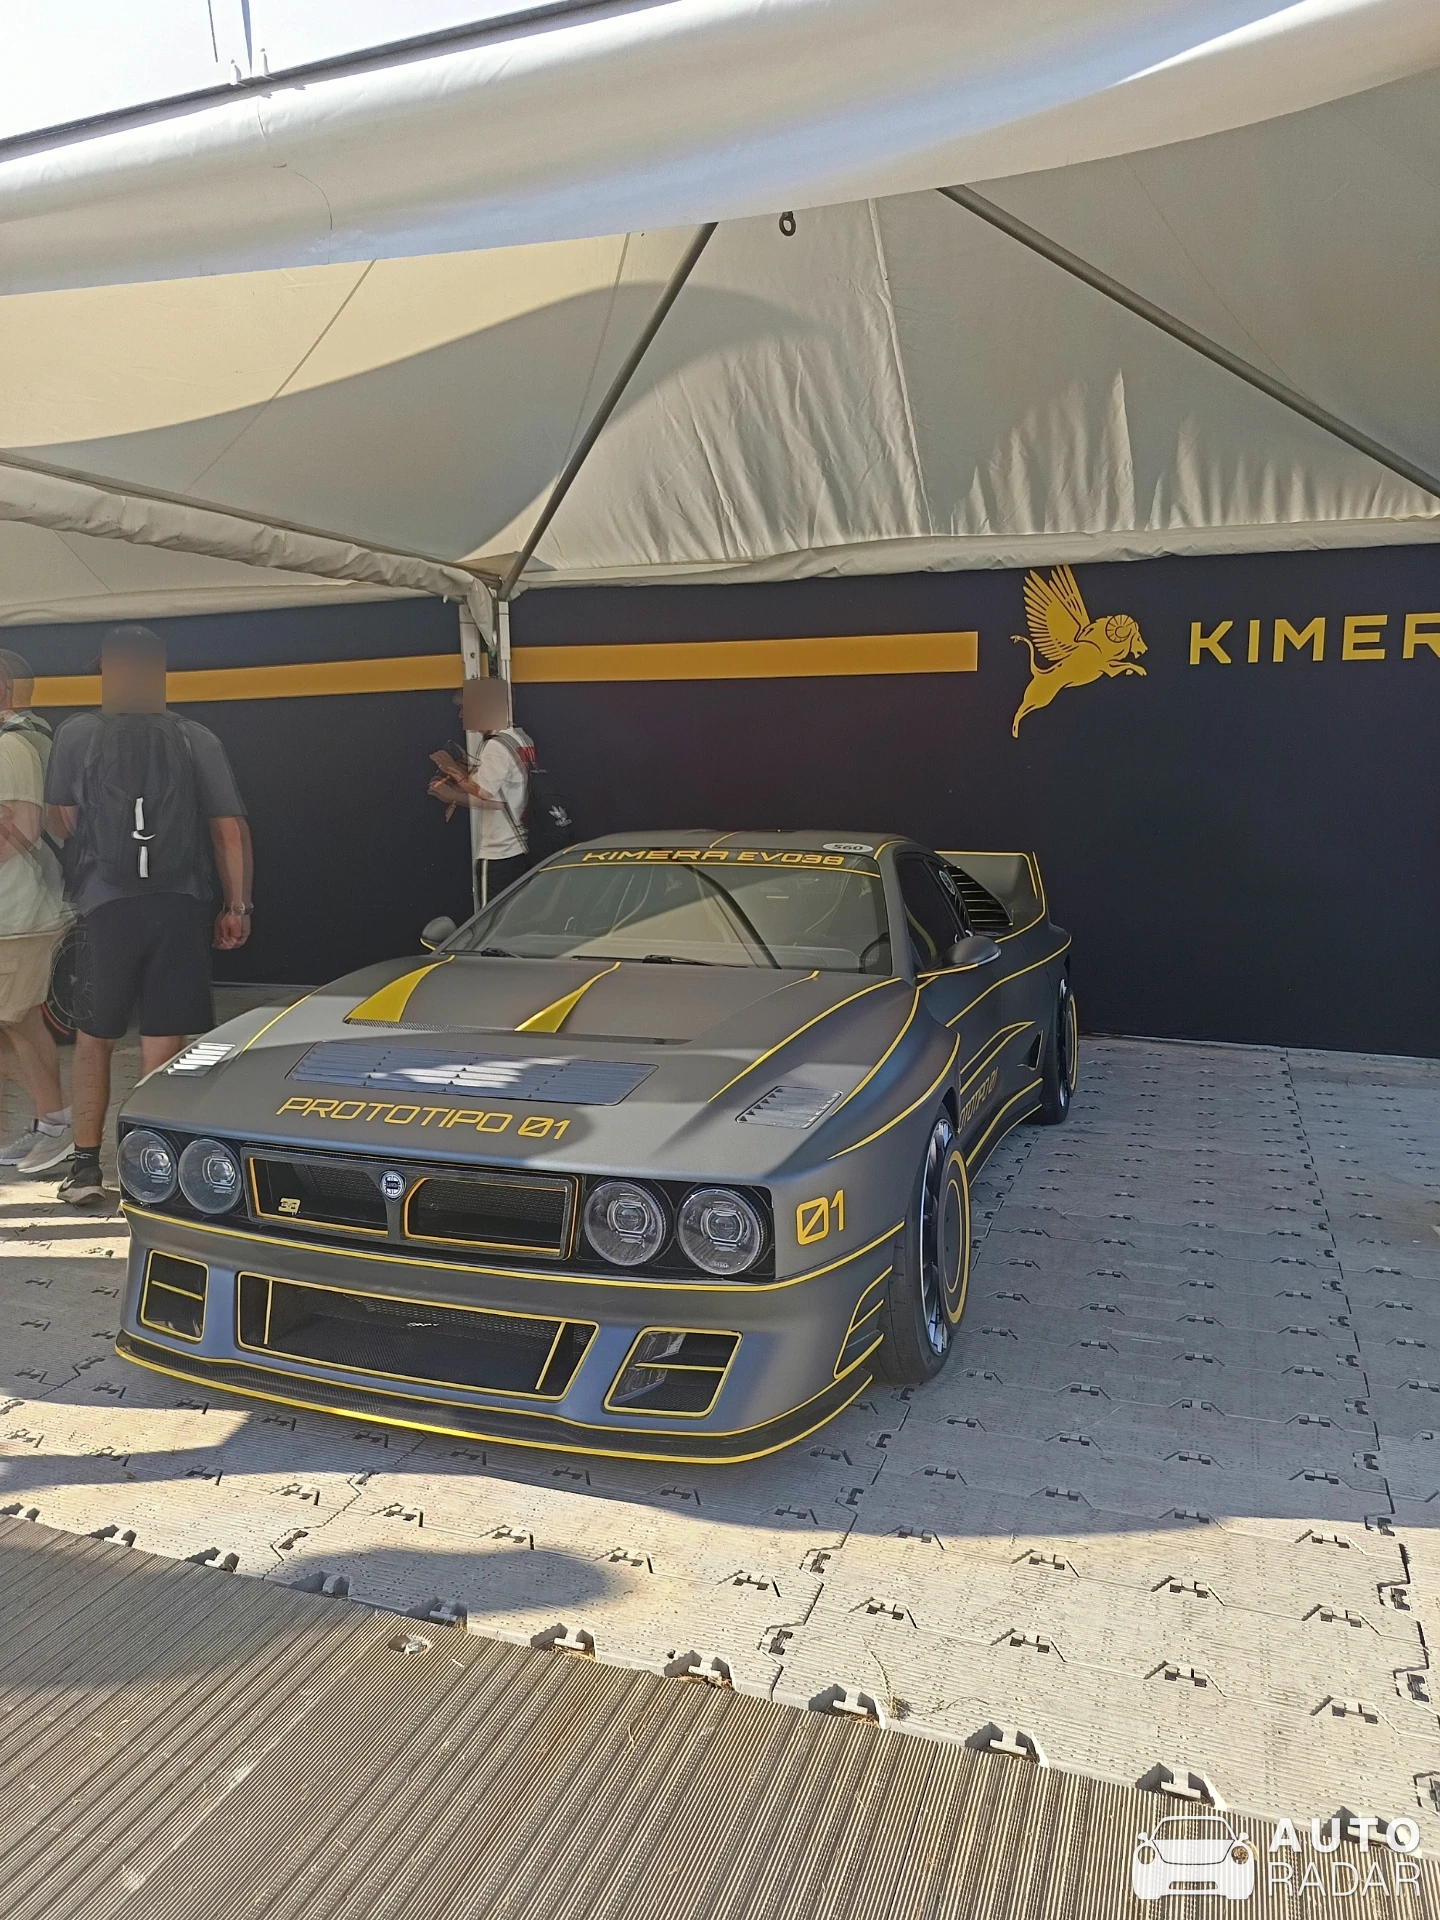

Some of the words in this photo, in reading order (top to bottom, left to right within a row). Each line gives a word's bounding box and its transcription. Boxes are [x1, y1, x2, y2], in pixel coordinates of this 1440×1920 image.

[1189, 612, 1440, 665] KIMER
[582, 850, 729, 862] KIMERA
[276, 1097, 513, 1134] PROTOTIPO
[517, 1116, 571, 1140] 01
[796, 1189, 844, 1245] 01
